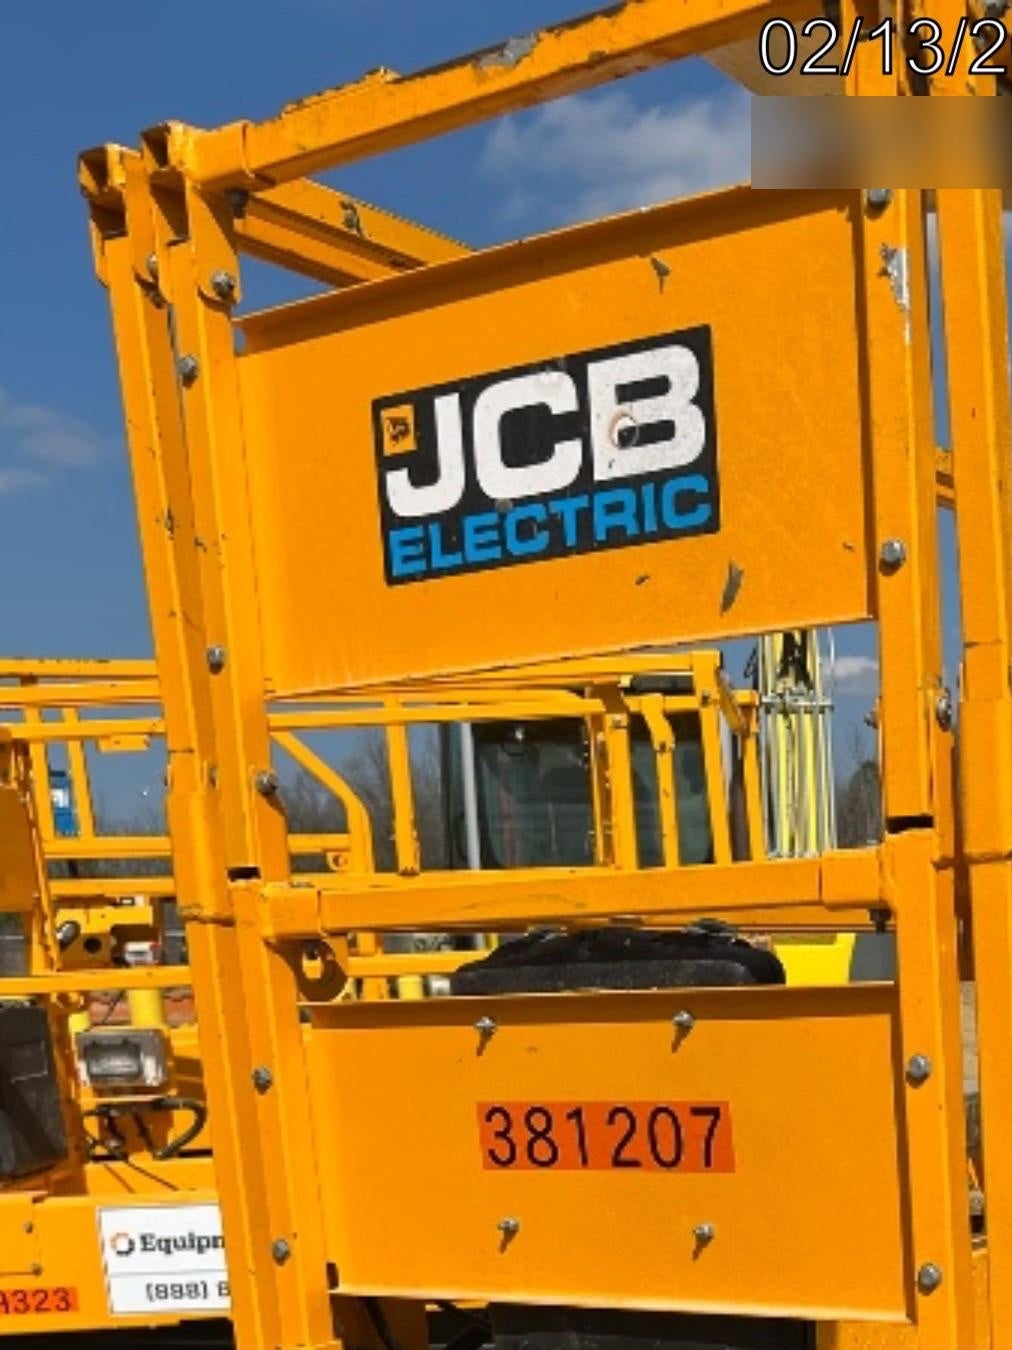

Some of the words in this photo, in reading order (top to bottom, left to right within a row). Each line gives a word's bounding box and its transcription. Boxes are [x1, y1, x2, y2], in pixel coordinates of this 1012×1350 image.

[386, 344, 706, 518] JCB
[389, 474, 712, 577] ELECTRIC
[485, 1105, 721, 1168] 381207
[146, 1280, 208, 1302] (888)
